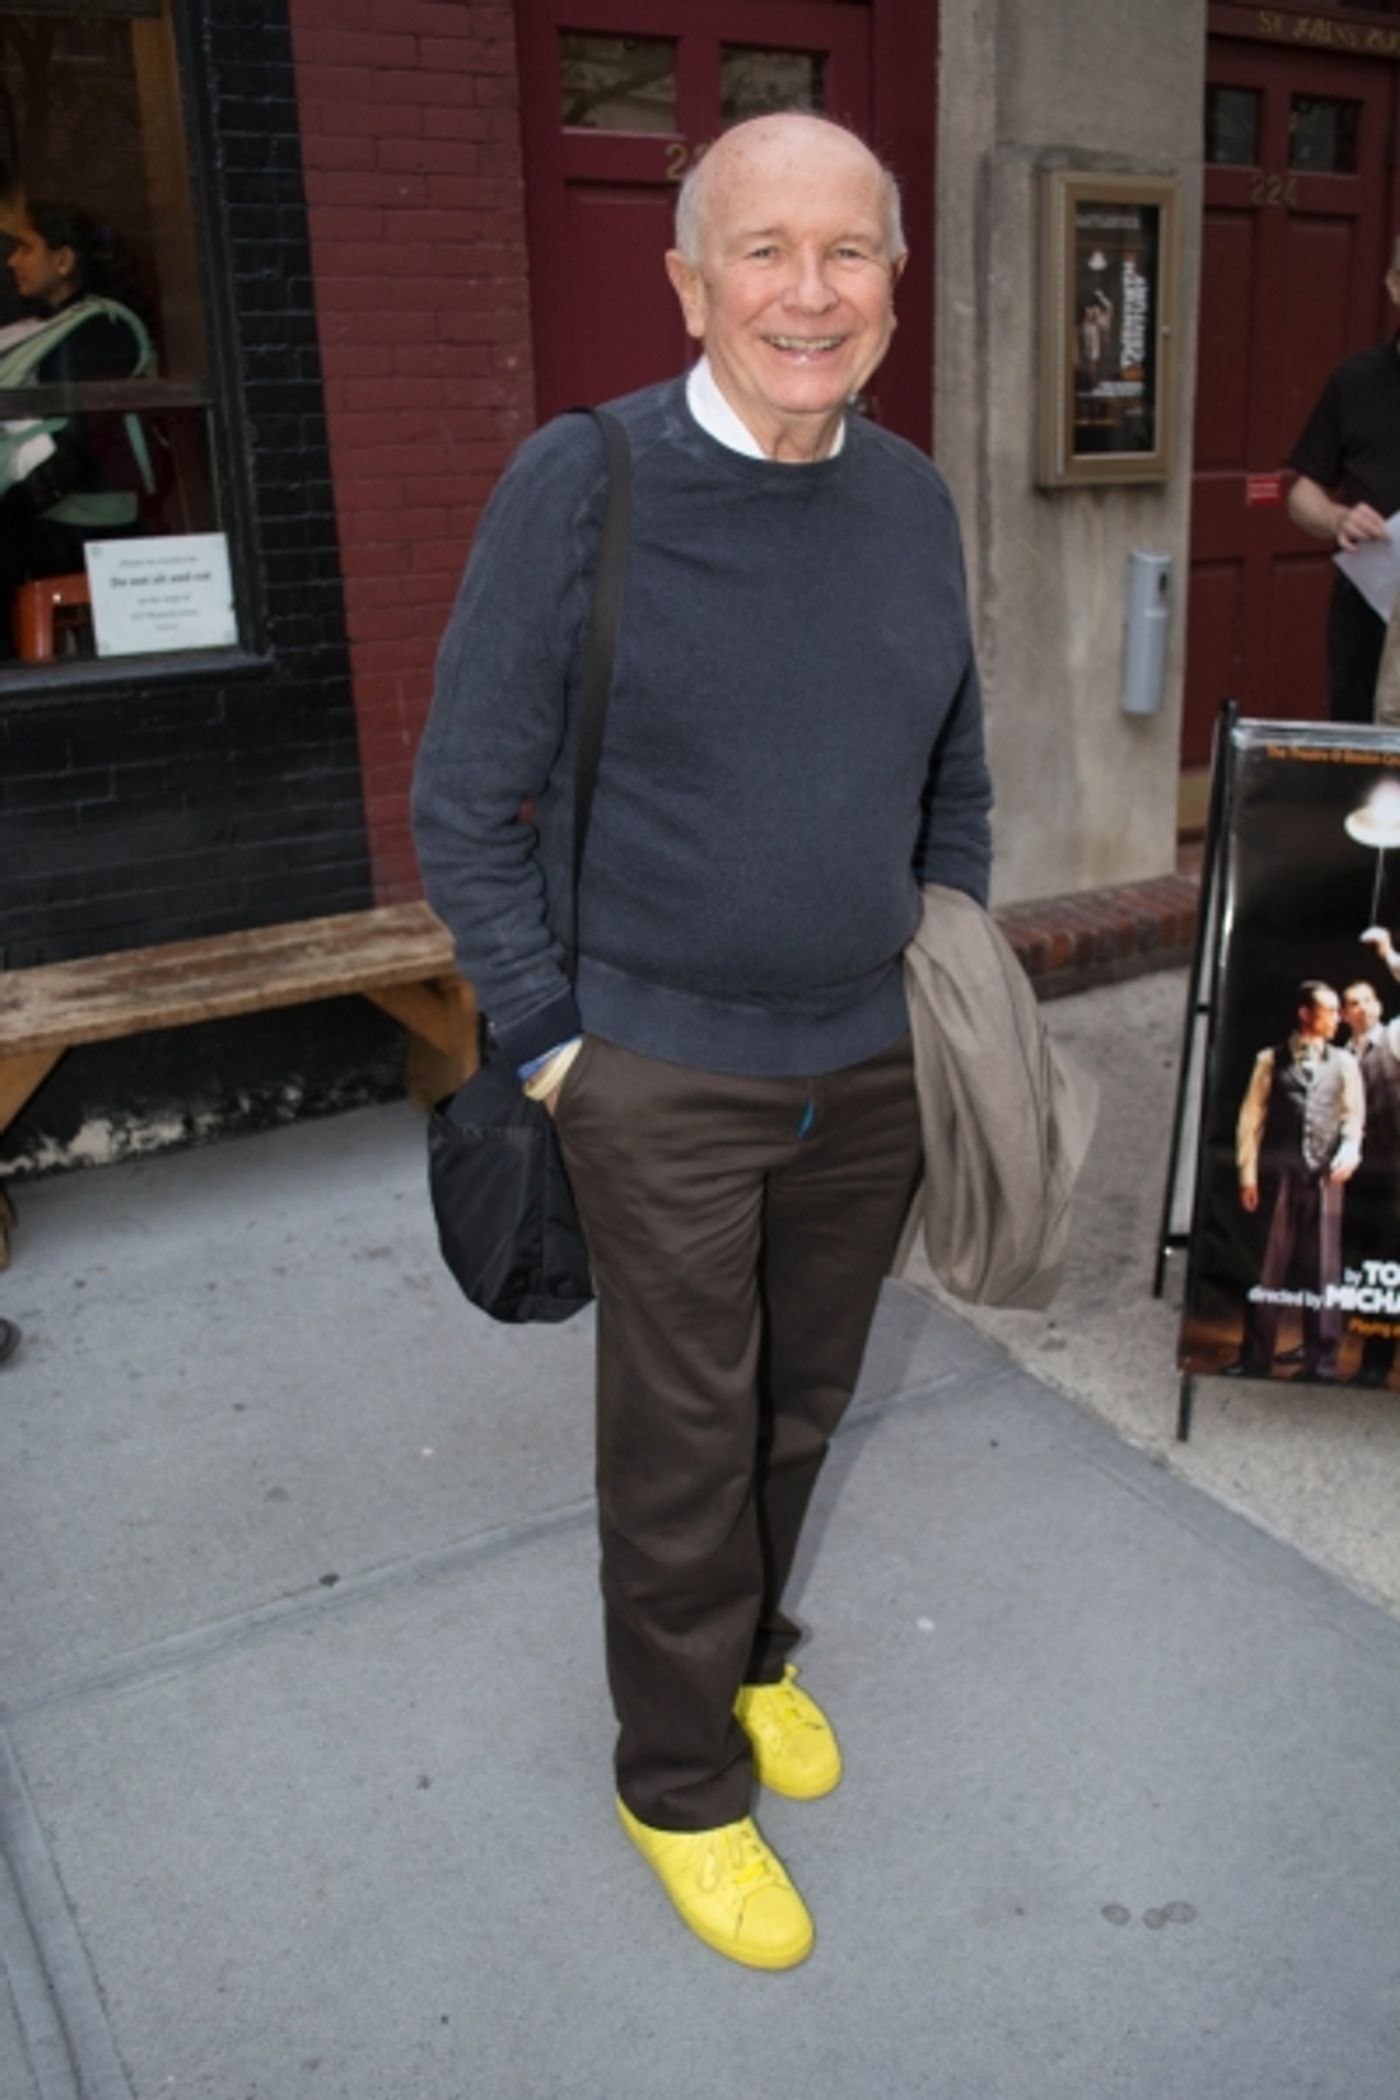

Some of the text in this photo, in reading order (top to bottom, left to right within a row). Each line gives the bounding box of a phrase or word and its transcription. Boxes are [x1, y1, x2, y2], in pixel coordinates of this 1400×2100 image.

[1344, 1267, 1362, 1286] by
[1248, 1285, 1303, 1307] directed
[1305, 1289, 1323, 1311] by
